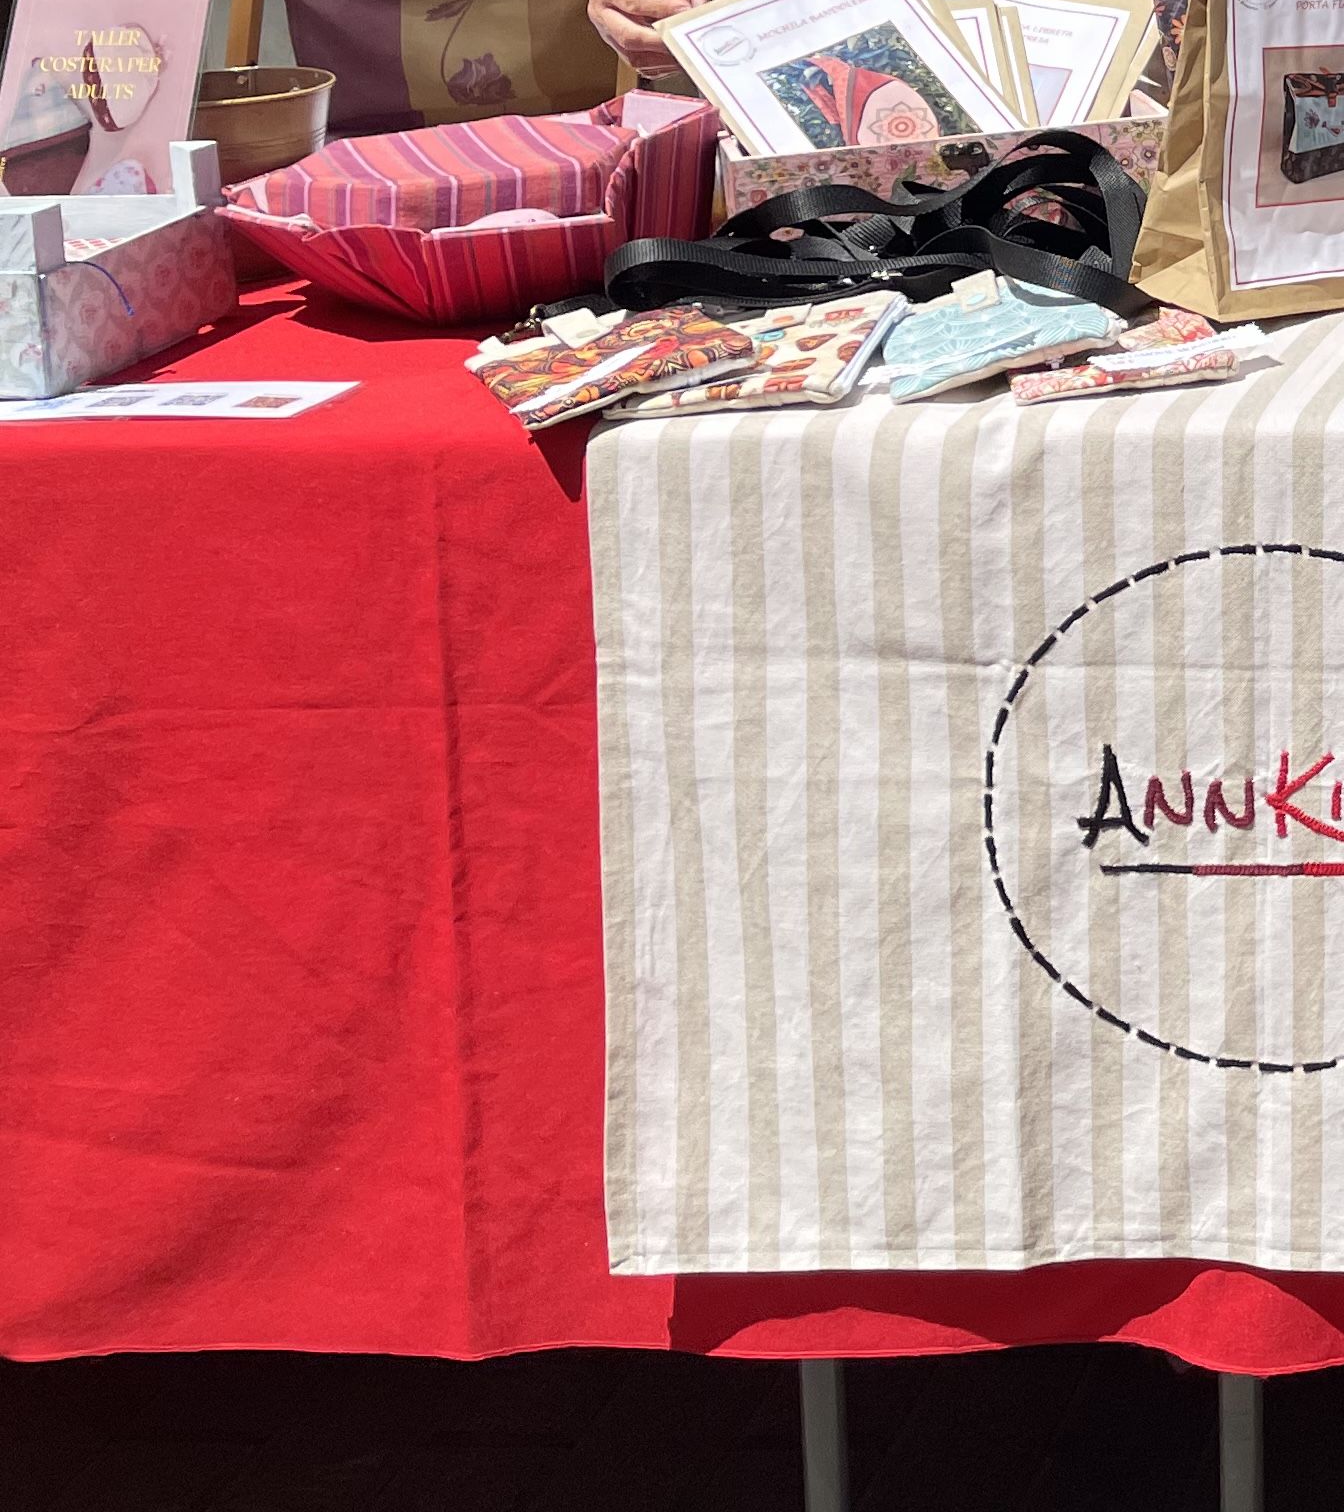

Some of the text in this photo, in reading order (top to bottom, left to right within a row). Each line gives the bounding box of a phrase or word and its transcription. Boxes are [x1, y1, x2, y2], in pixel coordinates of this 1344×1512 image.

[1296, 0, 1330, 12] PORTA
[74, 29, 142, 47] TALLER
[40, 56, 162, 73] COSTURA PER
[64, 83, 134, 100] ADULTS
